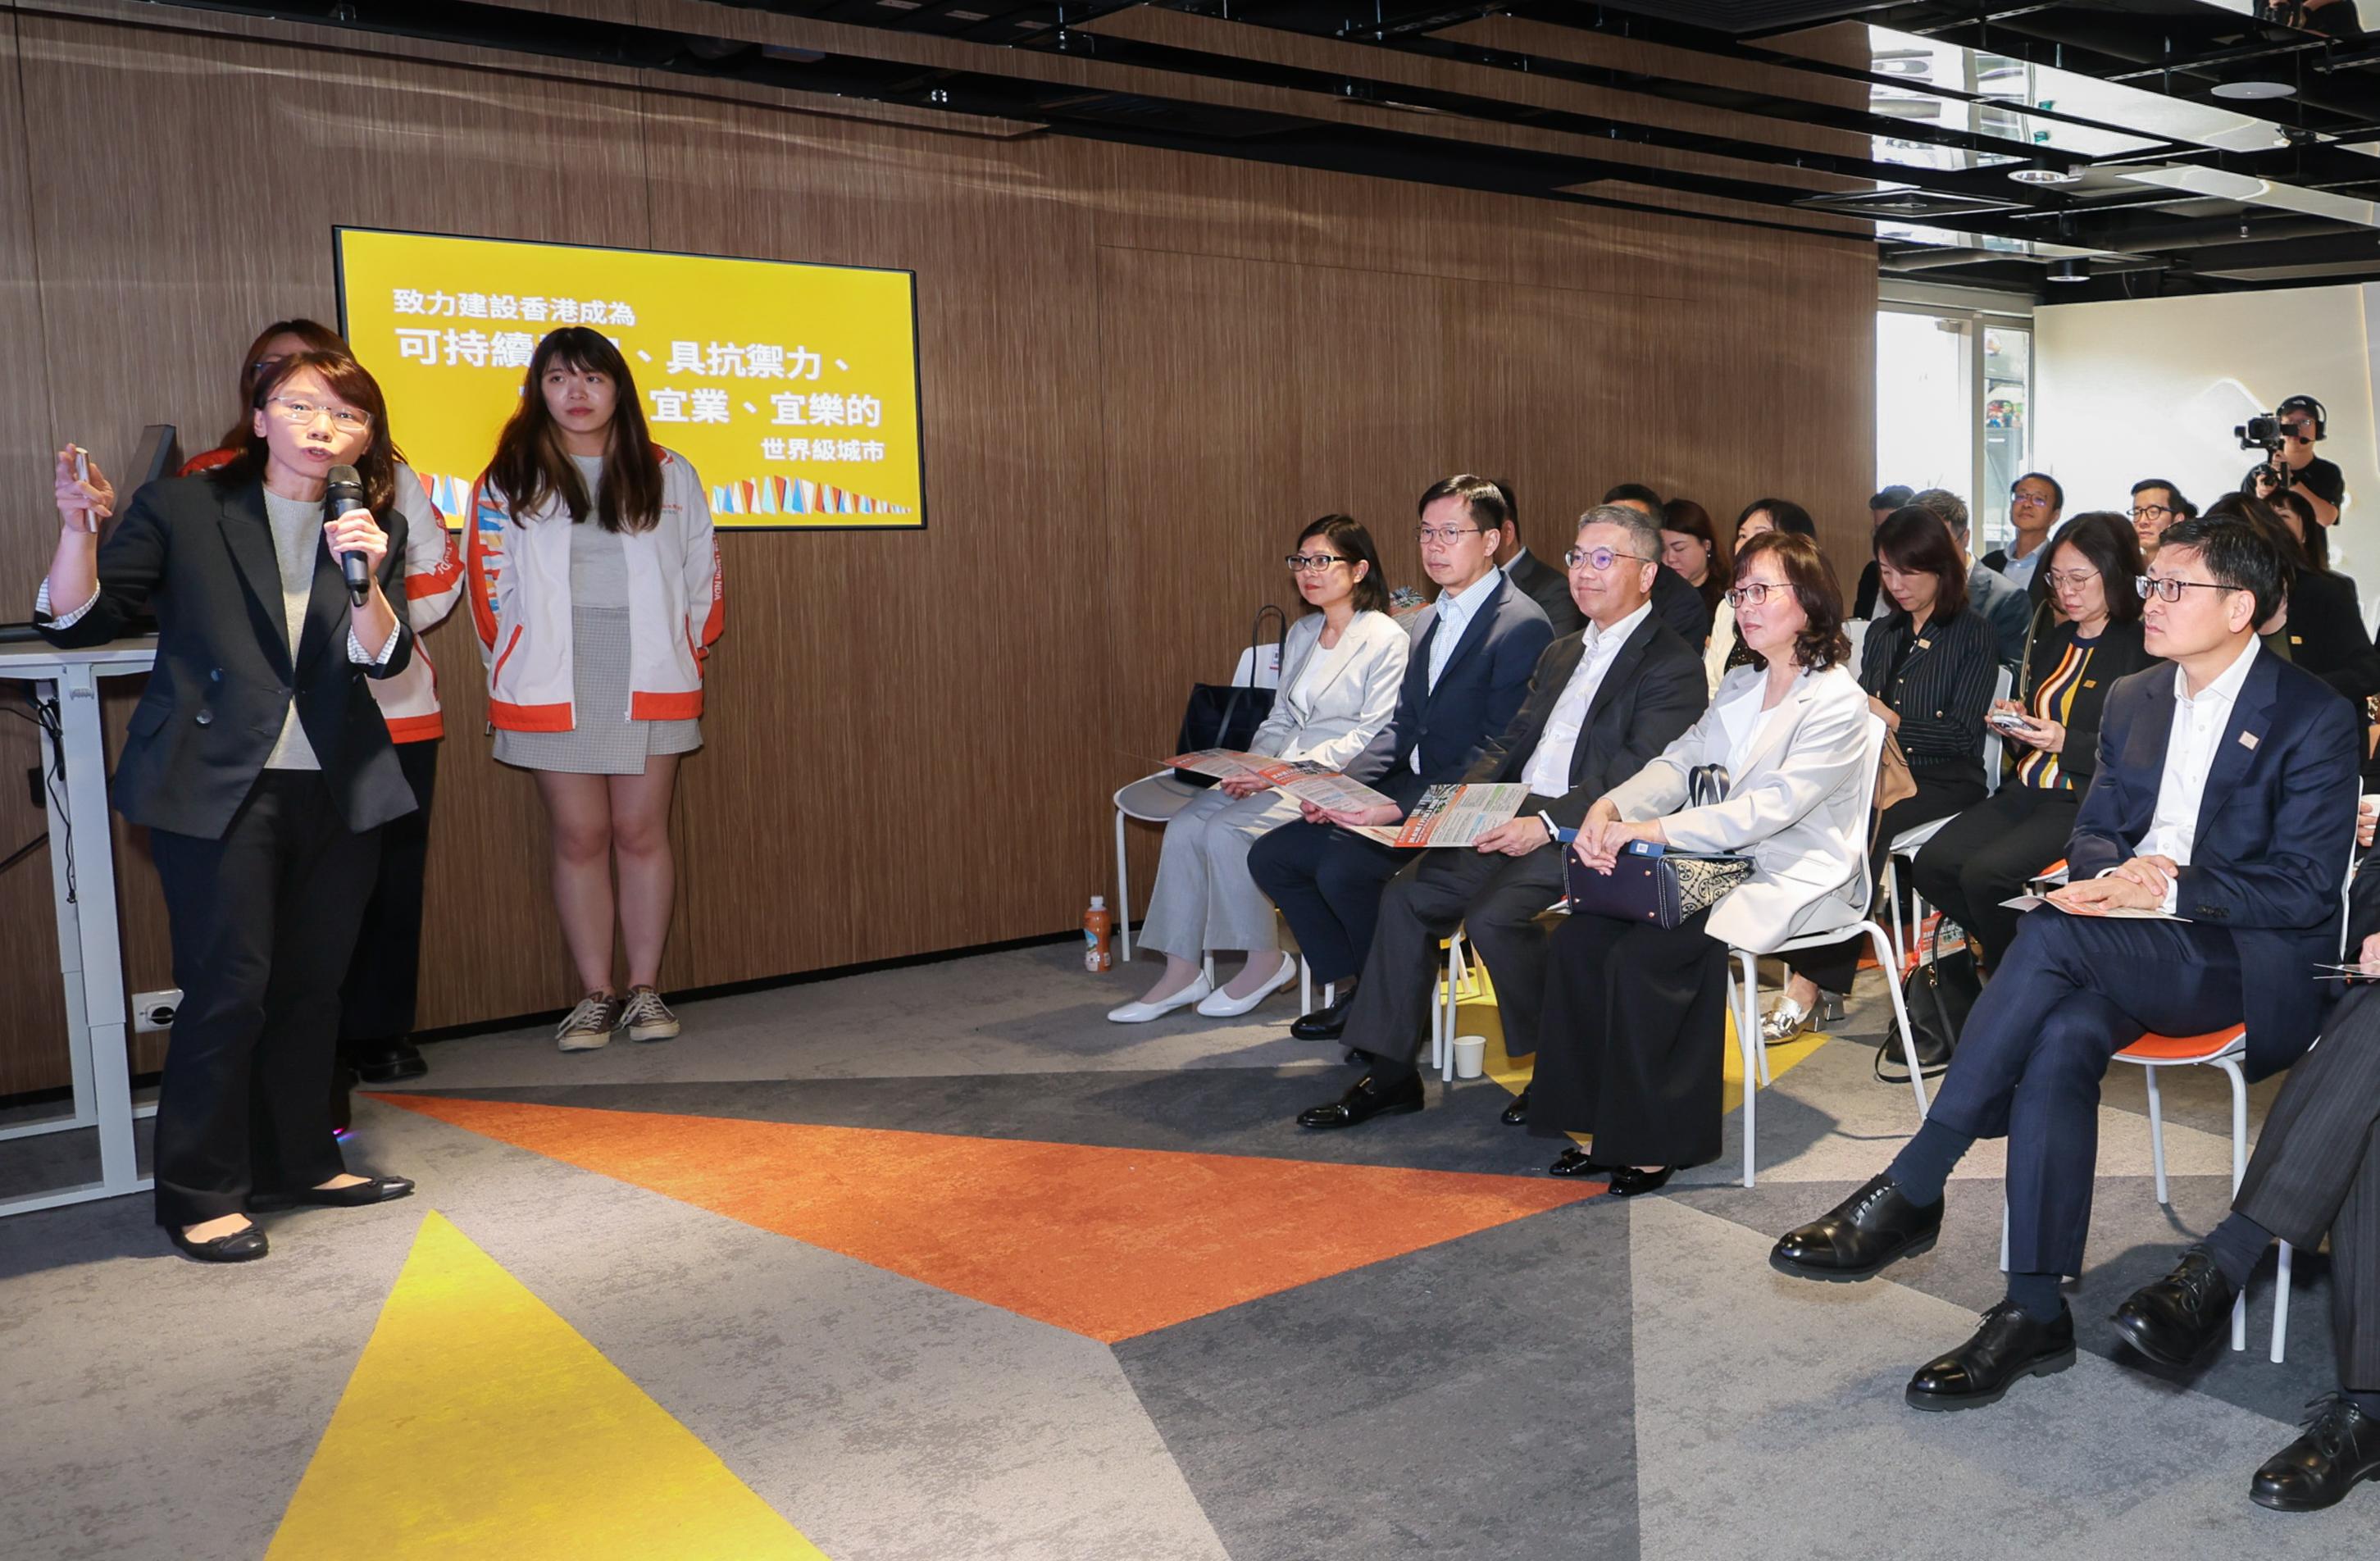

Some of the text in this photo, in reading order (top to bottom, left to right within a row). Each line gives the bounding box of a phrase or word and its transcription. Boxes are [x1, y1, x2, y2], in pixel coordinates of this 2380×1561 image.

[393, 289, 636, 326] 致力建設香港成為
[394, 327, 850, 381] 可持續、具抗禦力、
[519, 386, 881, 428] 宜業、宜樂的
[761, 438, 885, 462] 世界級城市
